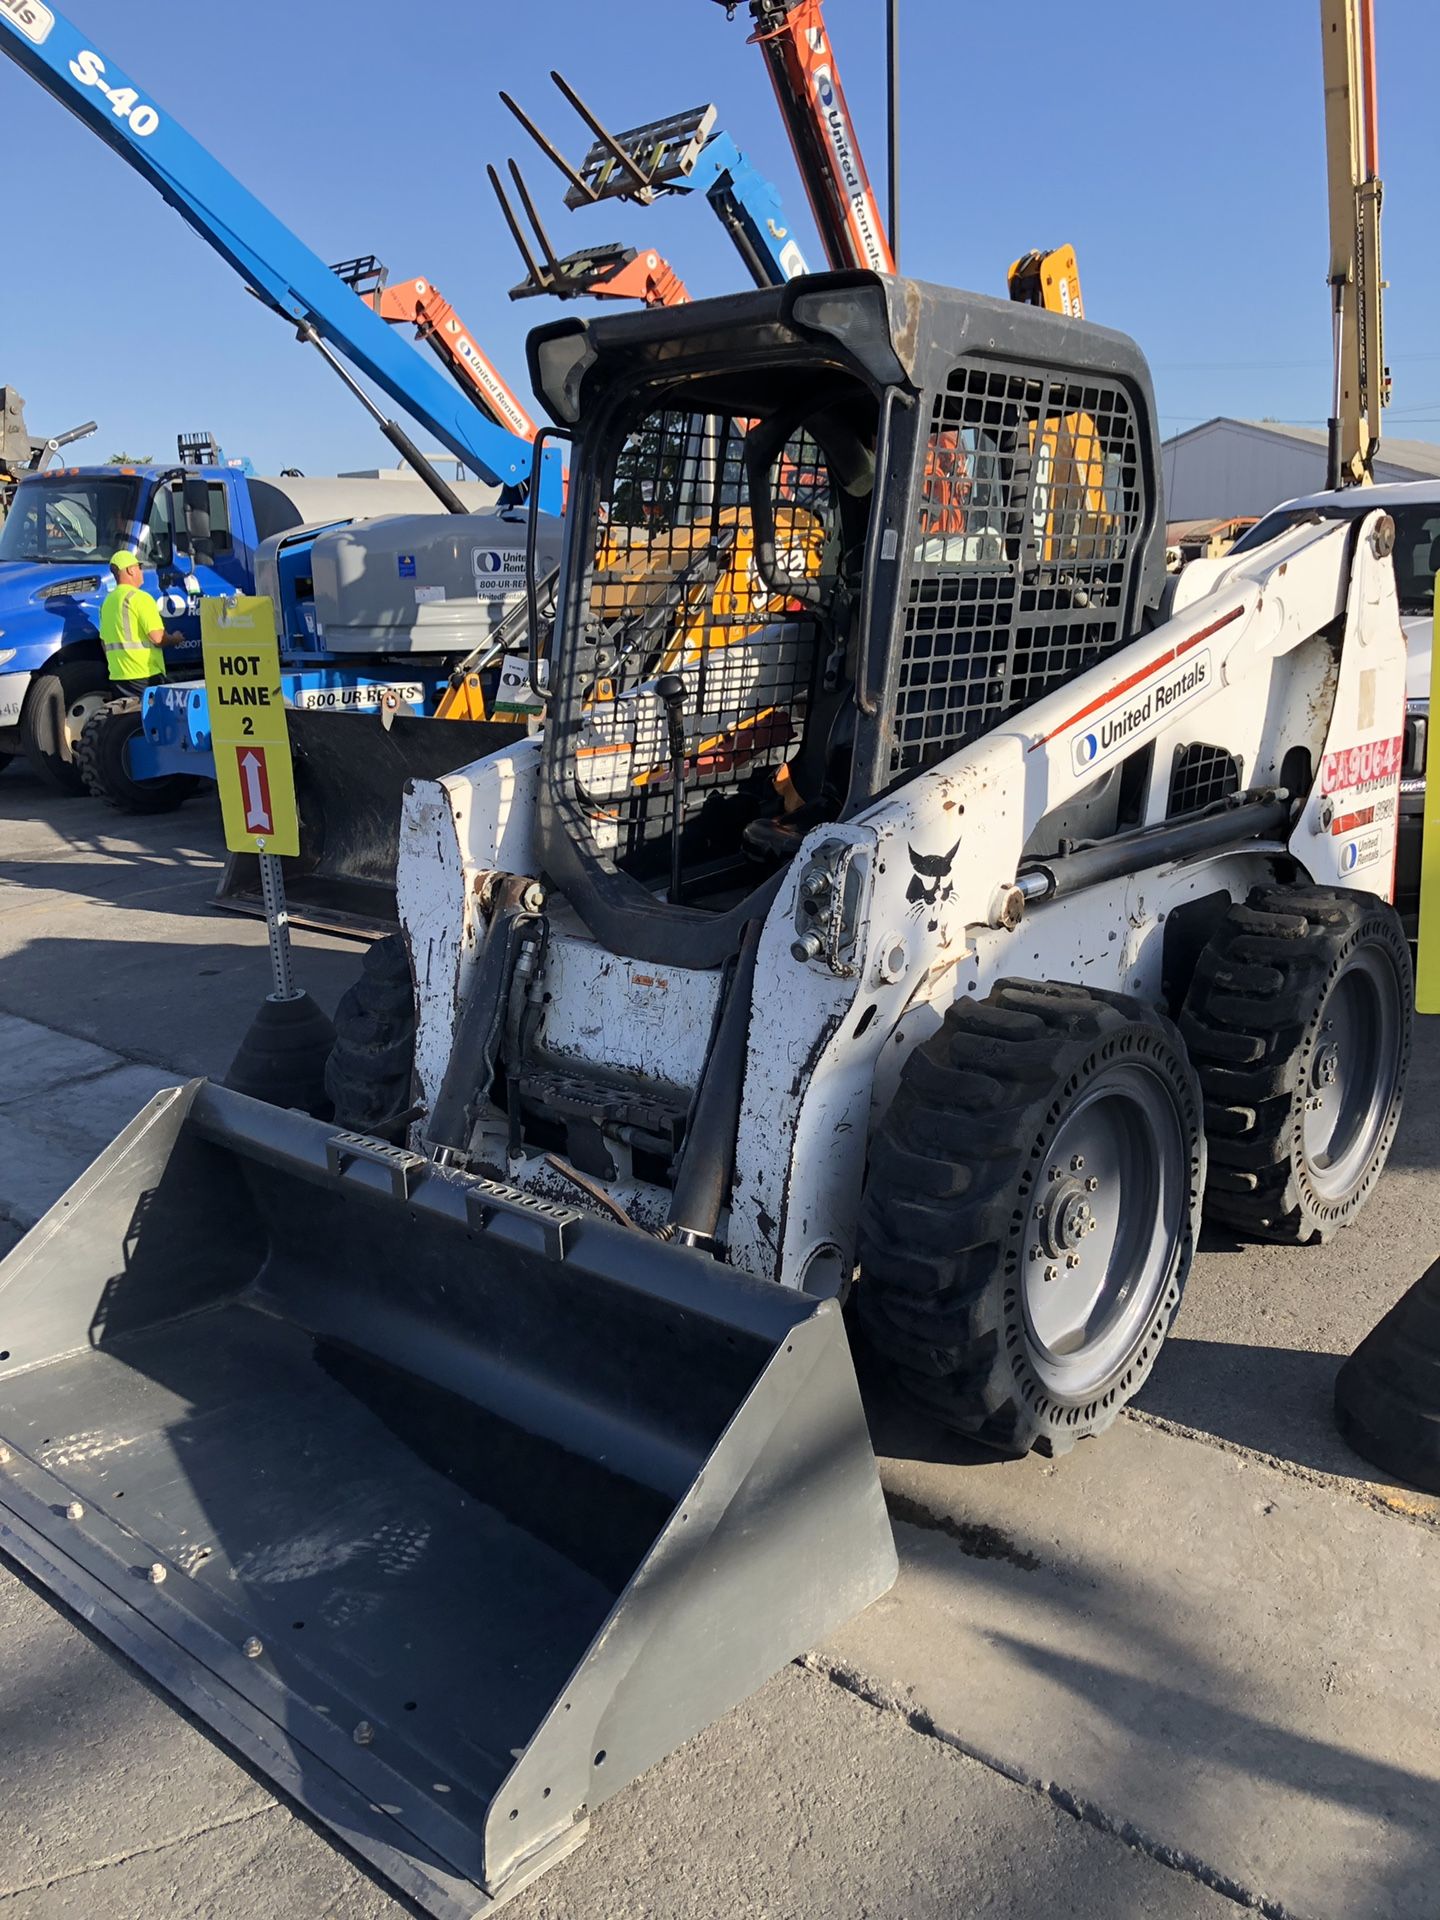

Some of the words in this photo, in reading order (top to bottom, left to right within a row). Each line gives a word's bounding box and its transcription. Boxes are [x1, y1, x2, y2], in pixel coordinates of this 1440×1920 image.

[69, 50, 159, 136] S-40
[828, 110, 858, 187] United
[852, 192, 880, 272] Rentals
[470, 356, 498, 392] United
[495, 391, 524, 430] Rentals
[502, 552, 526, 562] Unite
[220, 656, 260, 676] HOT
[218, 686, 270, 706] LANE
[1102, 695, 1151, 749] United
[1156, 662, 1205, 713] Rentals
[241, 716, 254, 735] 2
[1358, 834, 1379, 852] United
[1357, 849, 1379, 866] Rentals
